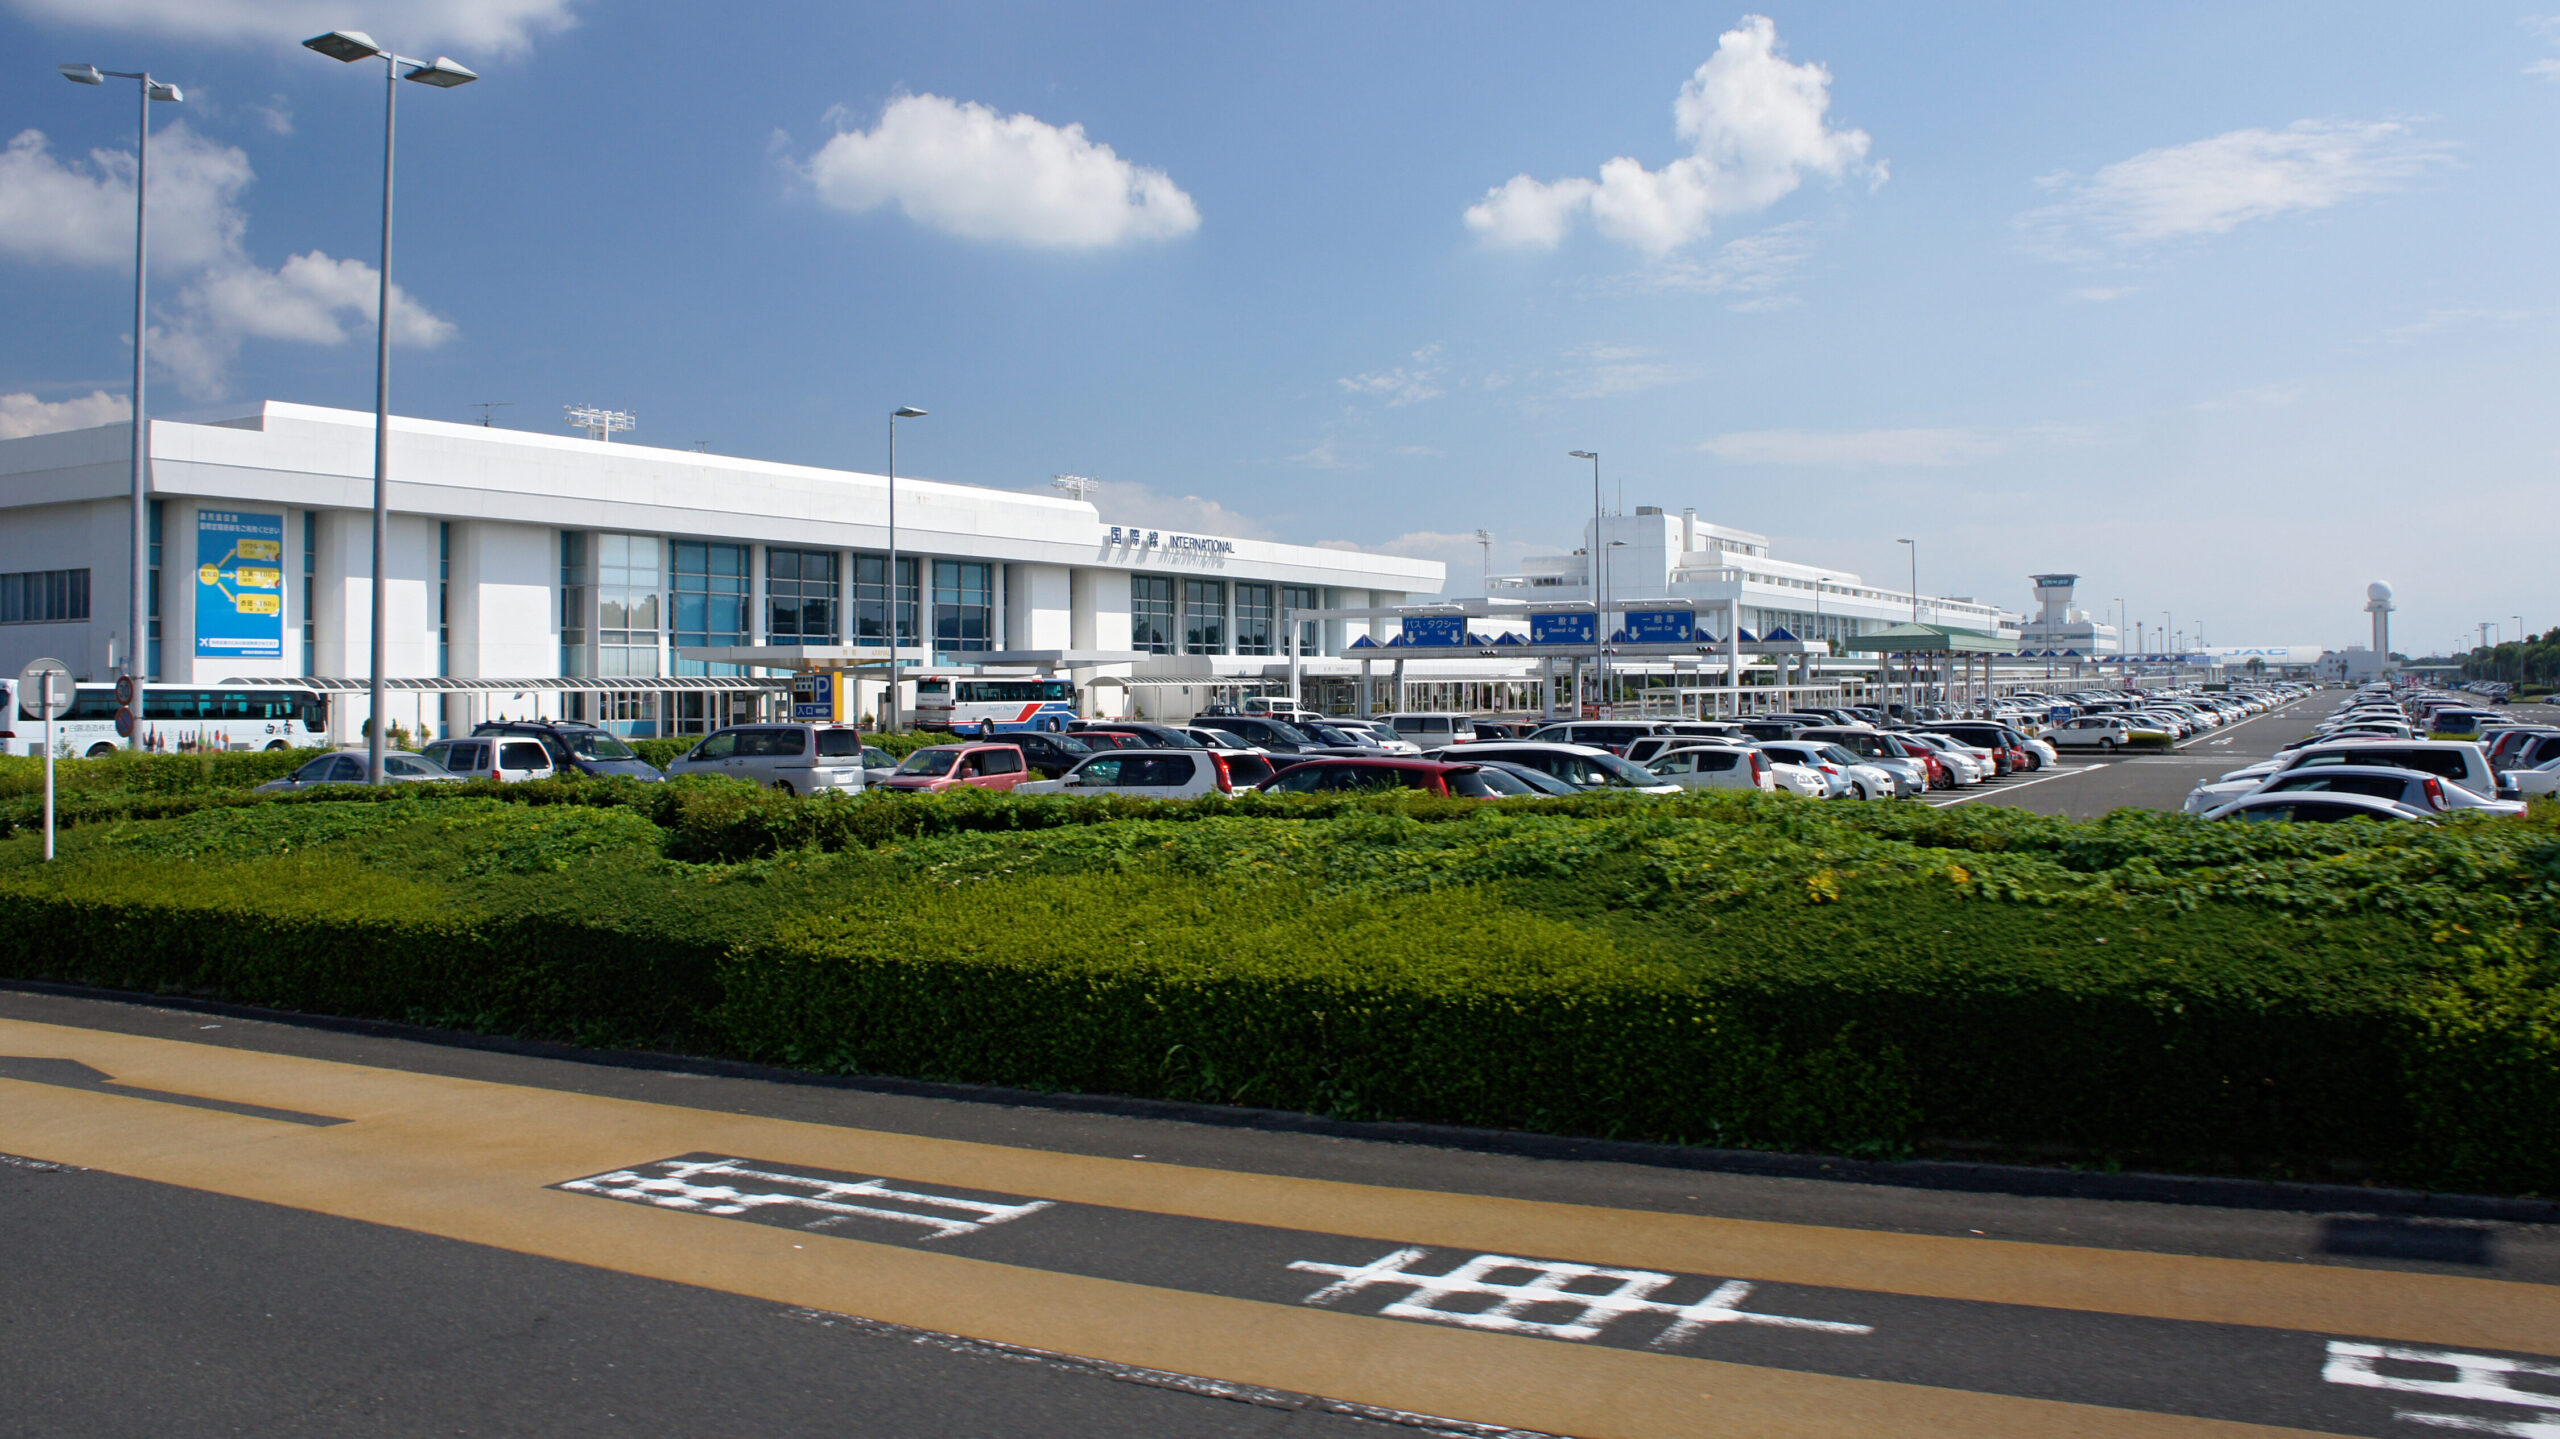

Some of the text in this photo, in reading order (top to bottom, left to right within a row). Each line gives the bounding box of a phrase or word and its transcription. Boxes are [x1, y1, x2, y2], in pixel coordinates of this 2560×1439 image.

[1111, 526, 1236, 554] 国際線 INTERNATIONAL
[2222, 648, 2288, 656] JAC
[816, 676, 830, 702] P
[797, 706, 814, 716] 入口
